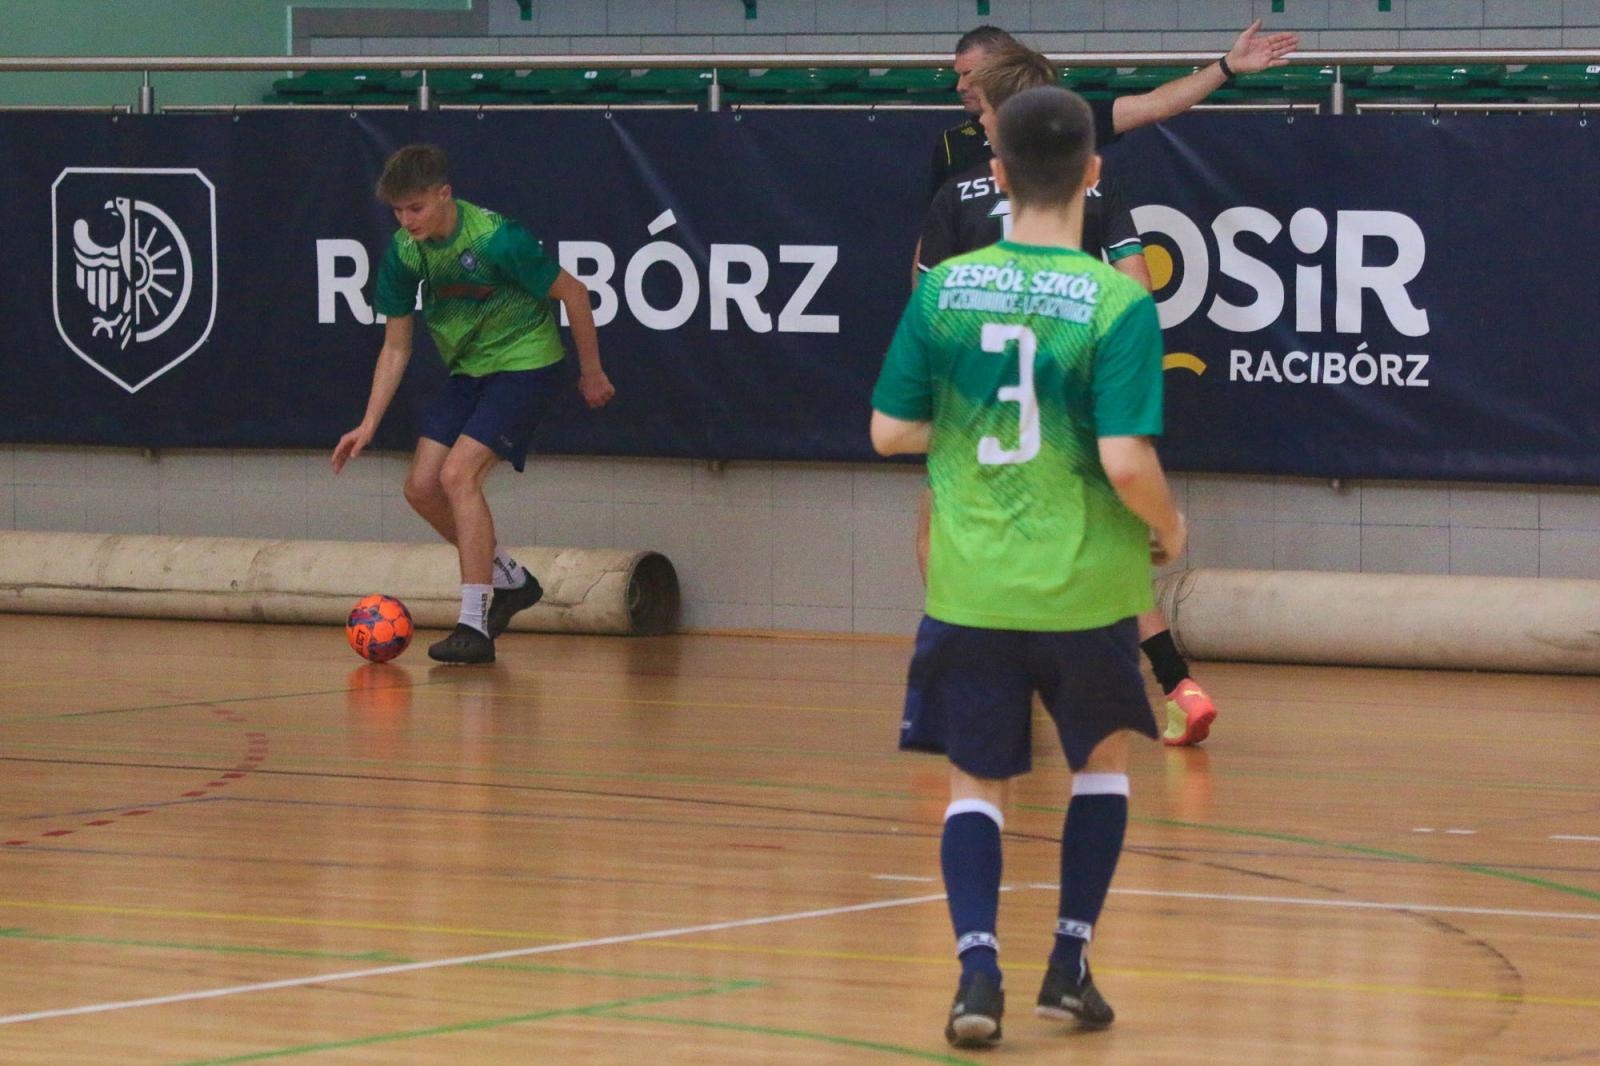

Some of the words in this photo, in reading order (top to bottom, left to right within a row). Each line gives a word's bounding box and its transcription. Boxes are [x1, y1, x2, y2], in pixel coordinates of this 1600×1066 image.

[315, 208, 840, 334] RBÓRZ
[944, 260, 1025, 293] ZESPÓŁ
[1030, 270, 1099, 304] SZKÓŁ
[977, 322, 1041, 465] 3
[1229, 341, 1430, 387] RACIBÓRZ
